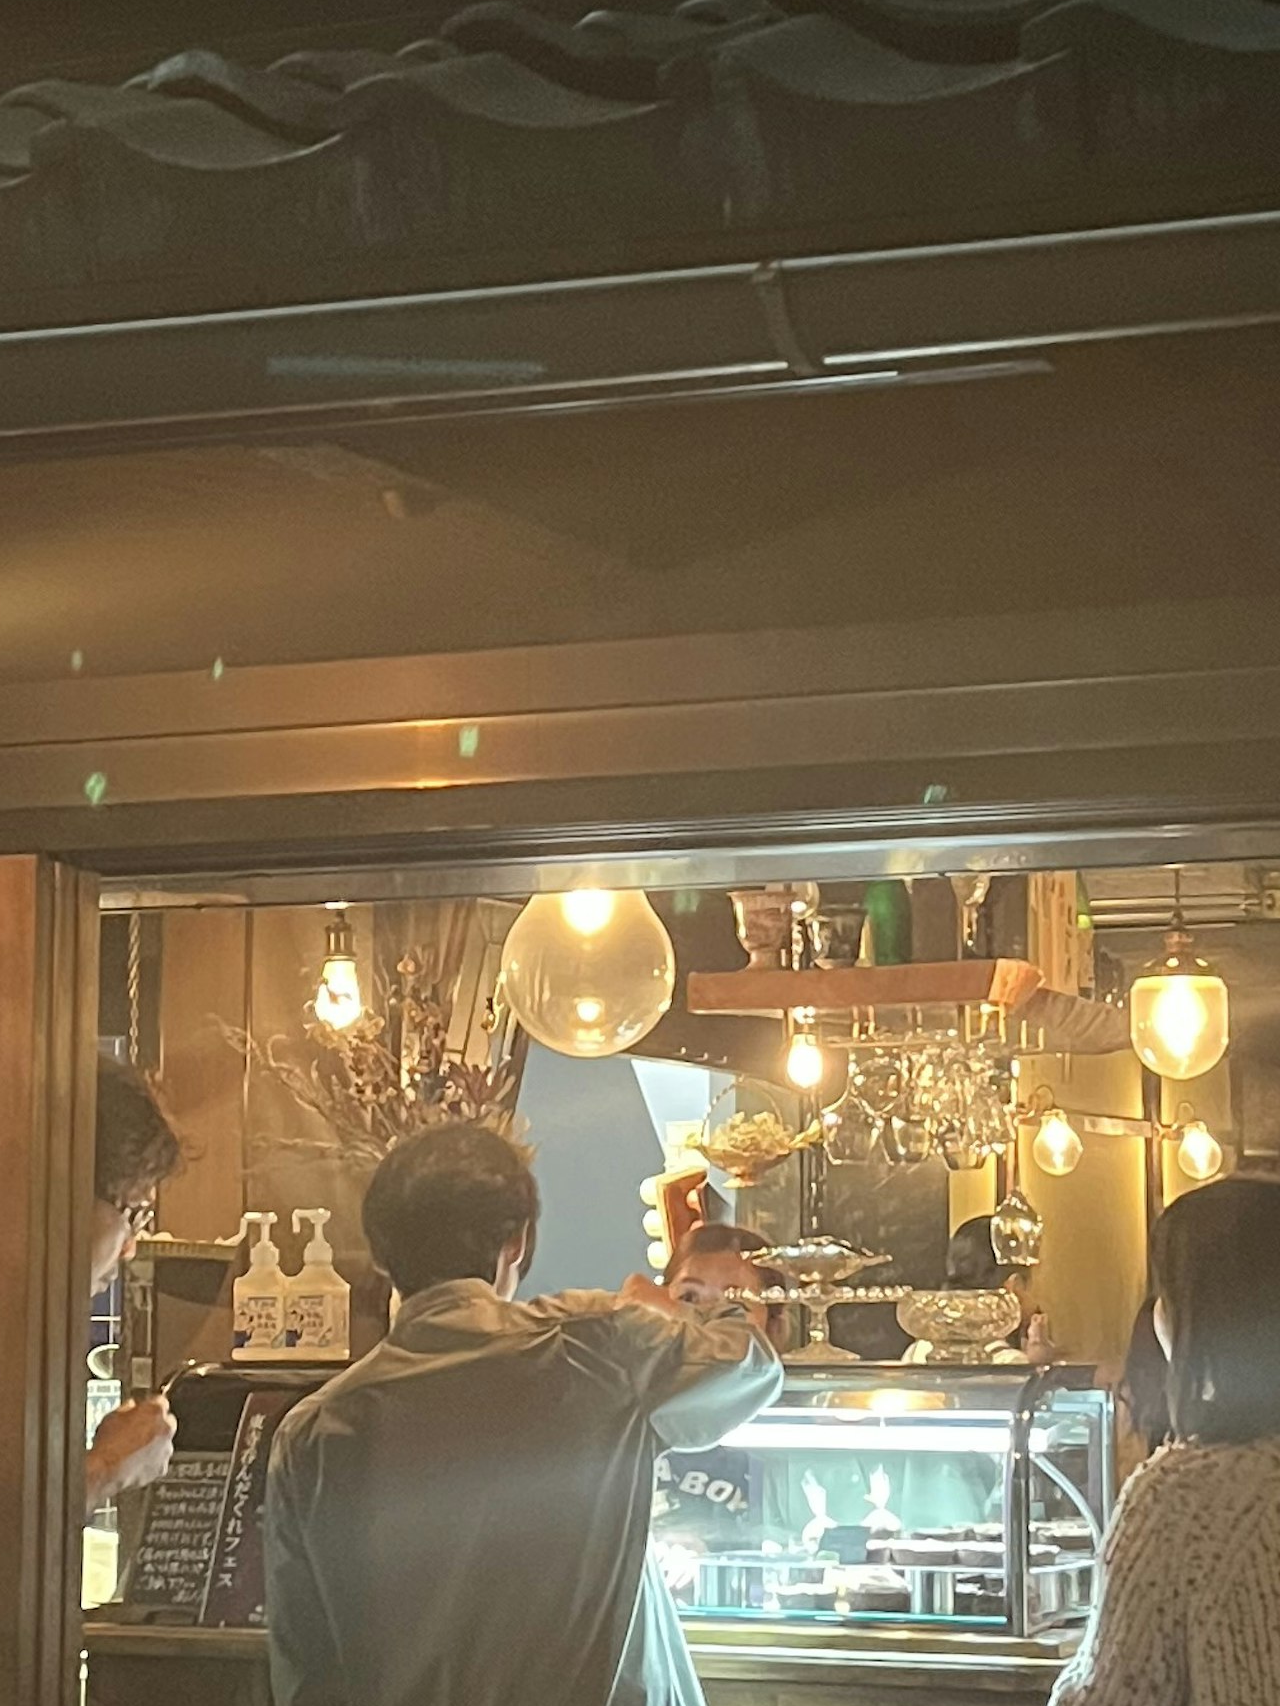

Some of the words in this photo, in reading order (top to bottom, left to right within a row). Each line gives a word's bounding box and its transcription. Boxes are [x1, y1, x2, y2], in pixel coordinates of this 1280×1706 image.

[215, 1412, 267, 1587] のんだくれフェス
